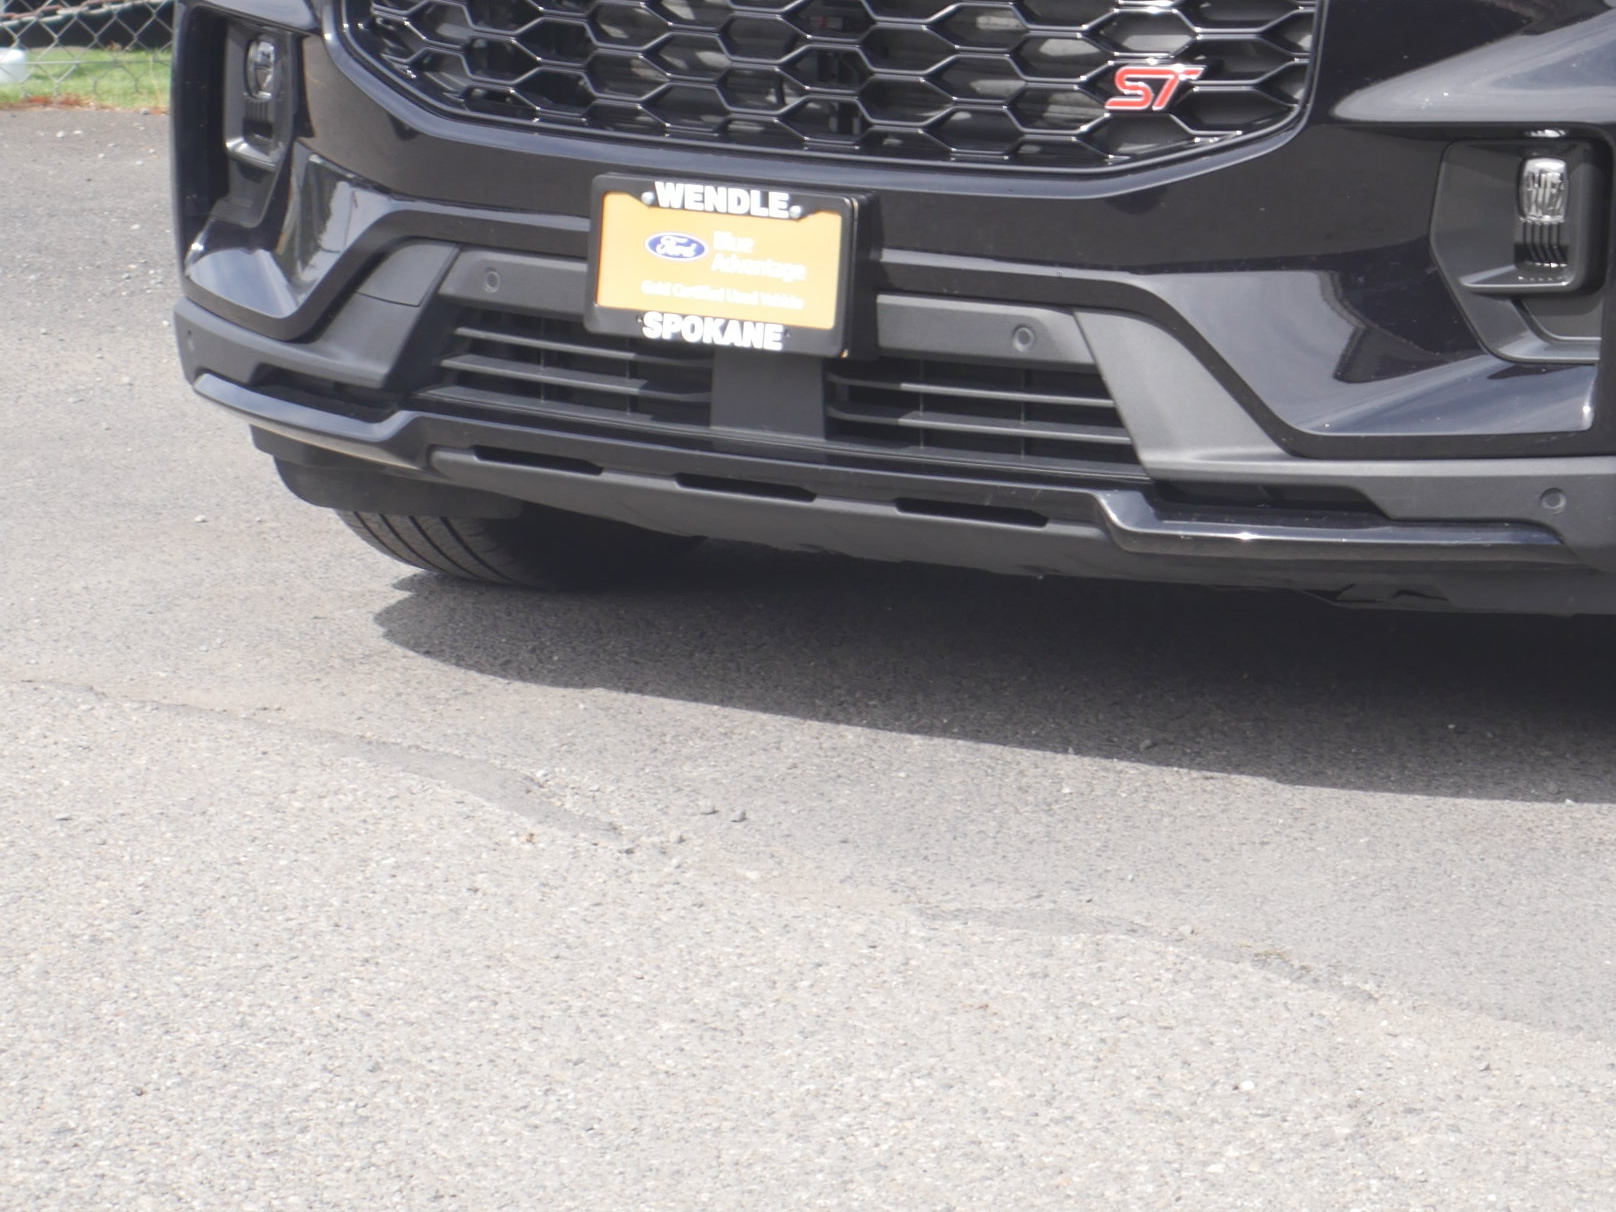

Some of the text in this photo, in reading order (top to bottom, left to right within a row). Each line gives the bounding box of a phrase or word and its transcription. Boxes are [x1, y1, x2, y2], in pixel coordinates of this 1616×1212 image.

[1104, 65, 1206, 111] ST
[654, 181, 790, 219] WENDLE
[655, 235, 698, 259] Ford
[641, 310, 784, 351] SPOKANE
